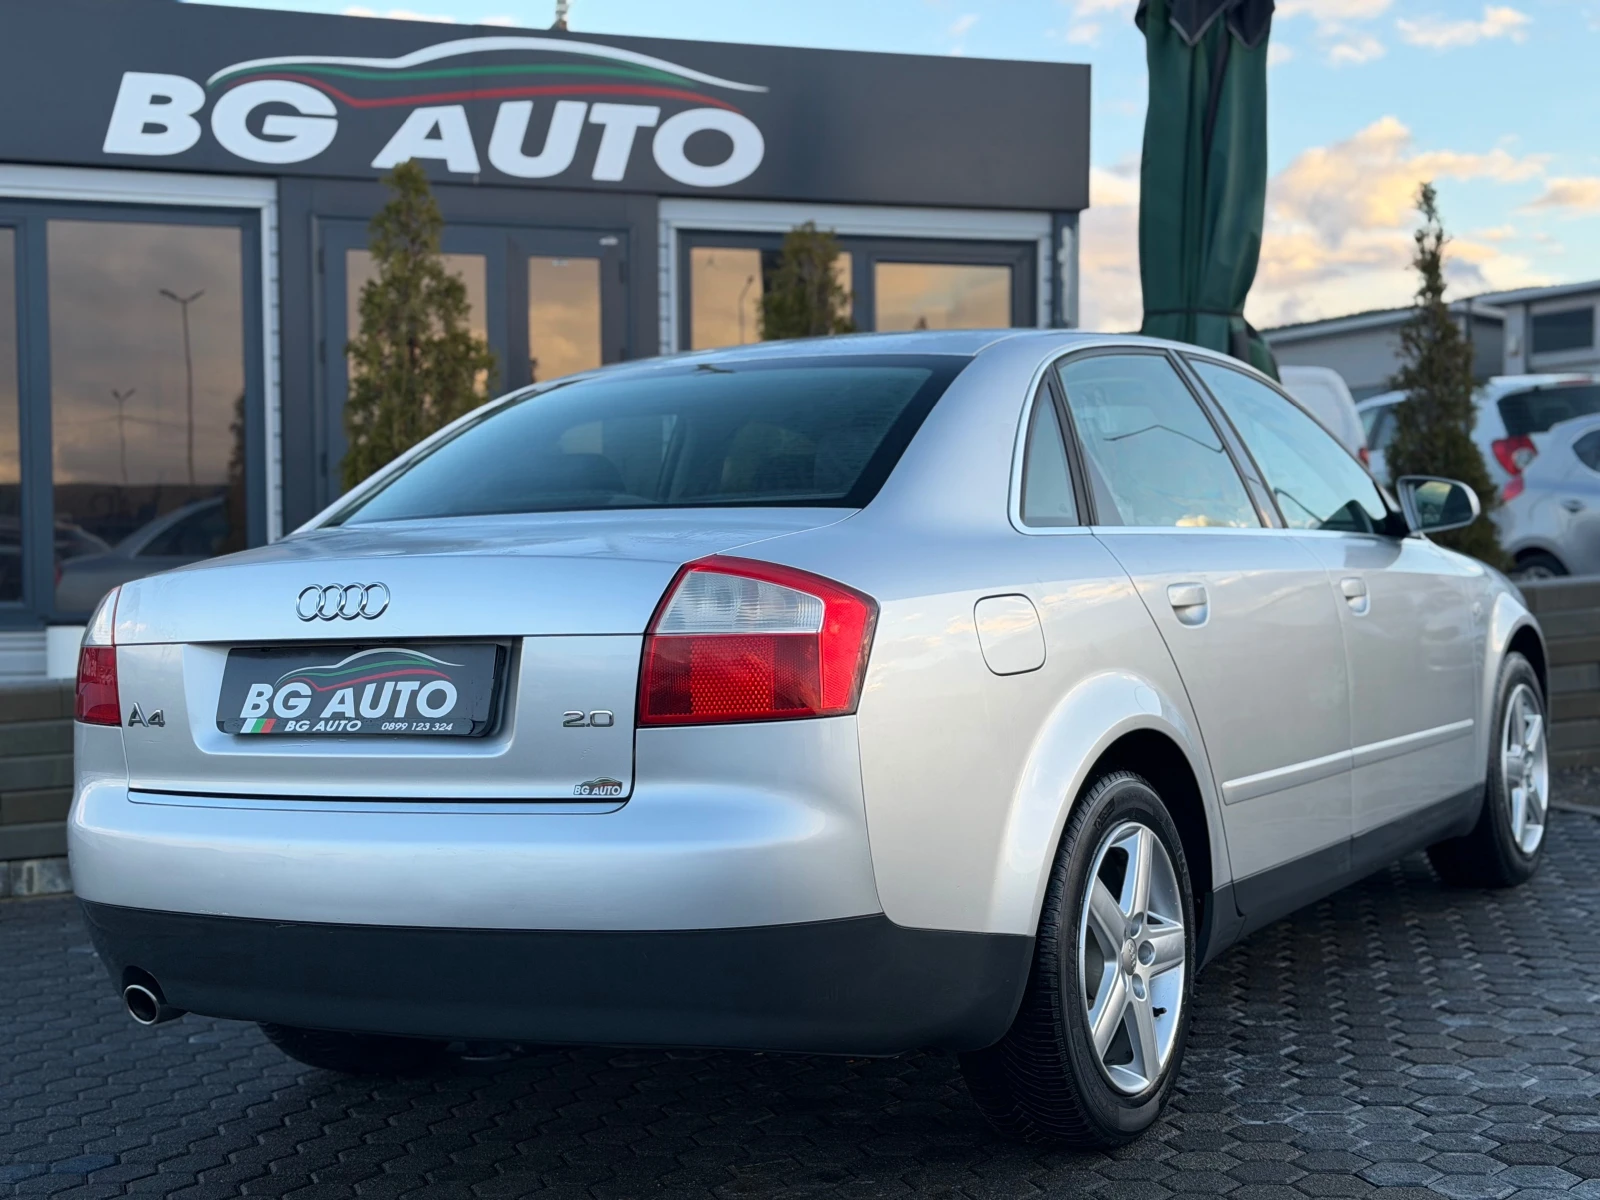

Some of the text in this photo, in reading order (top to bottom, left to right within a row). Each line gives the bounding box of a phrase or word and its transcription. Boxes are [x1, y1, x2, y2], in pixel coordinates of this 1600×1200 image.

[102, 71, 765, 188] BG AUTO
[239, 680, 458, 719] BG AUTO
[128, 701, 166, 728] A4
[284, 720, 454, 732] BG AUTO 0899 123 324
[562, 709, 615, 728] 2.0
[574, 785, 621, 795] BG AUTO
